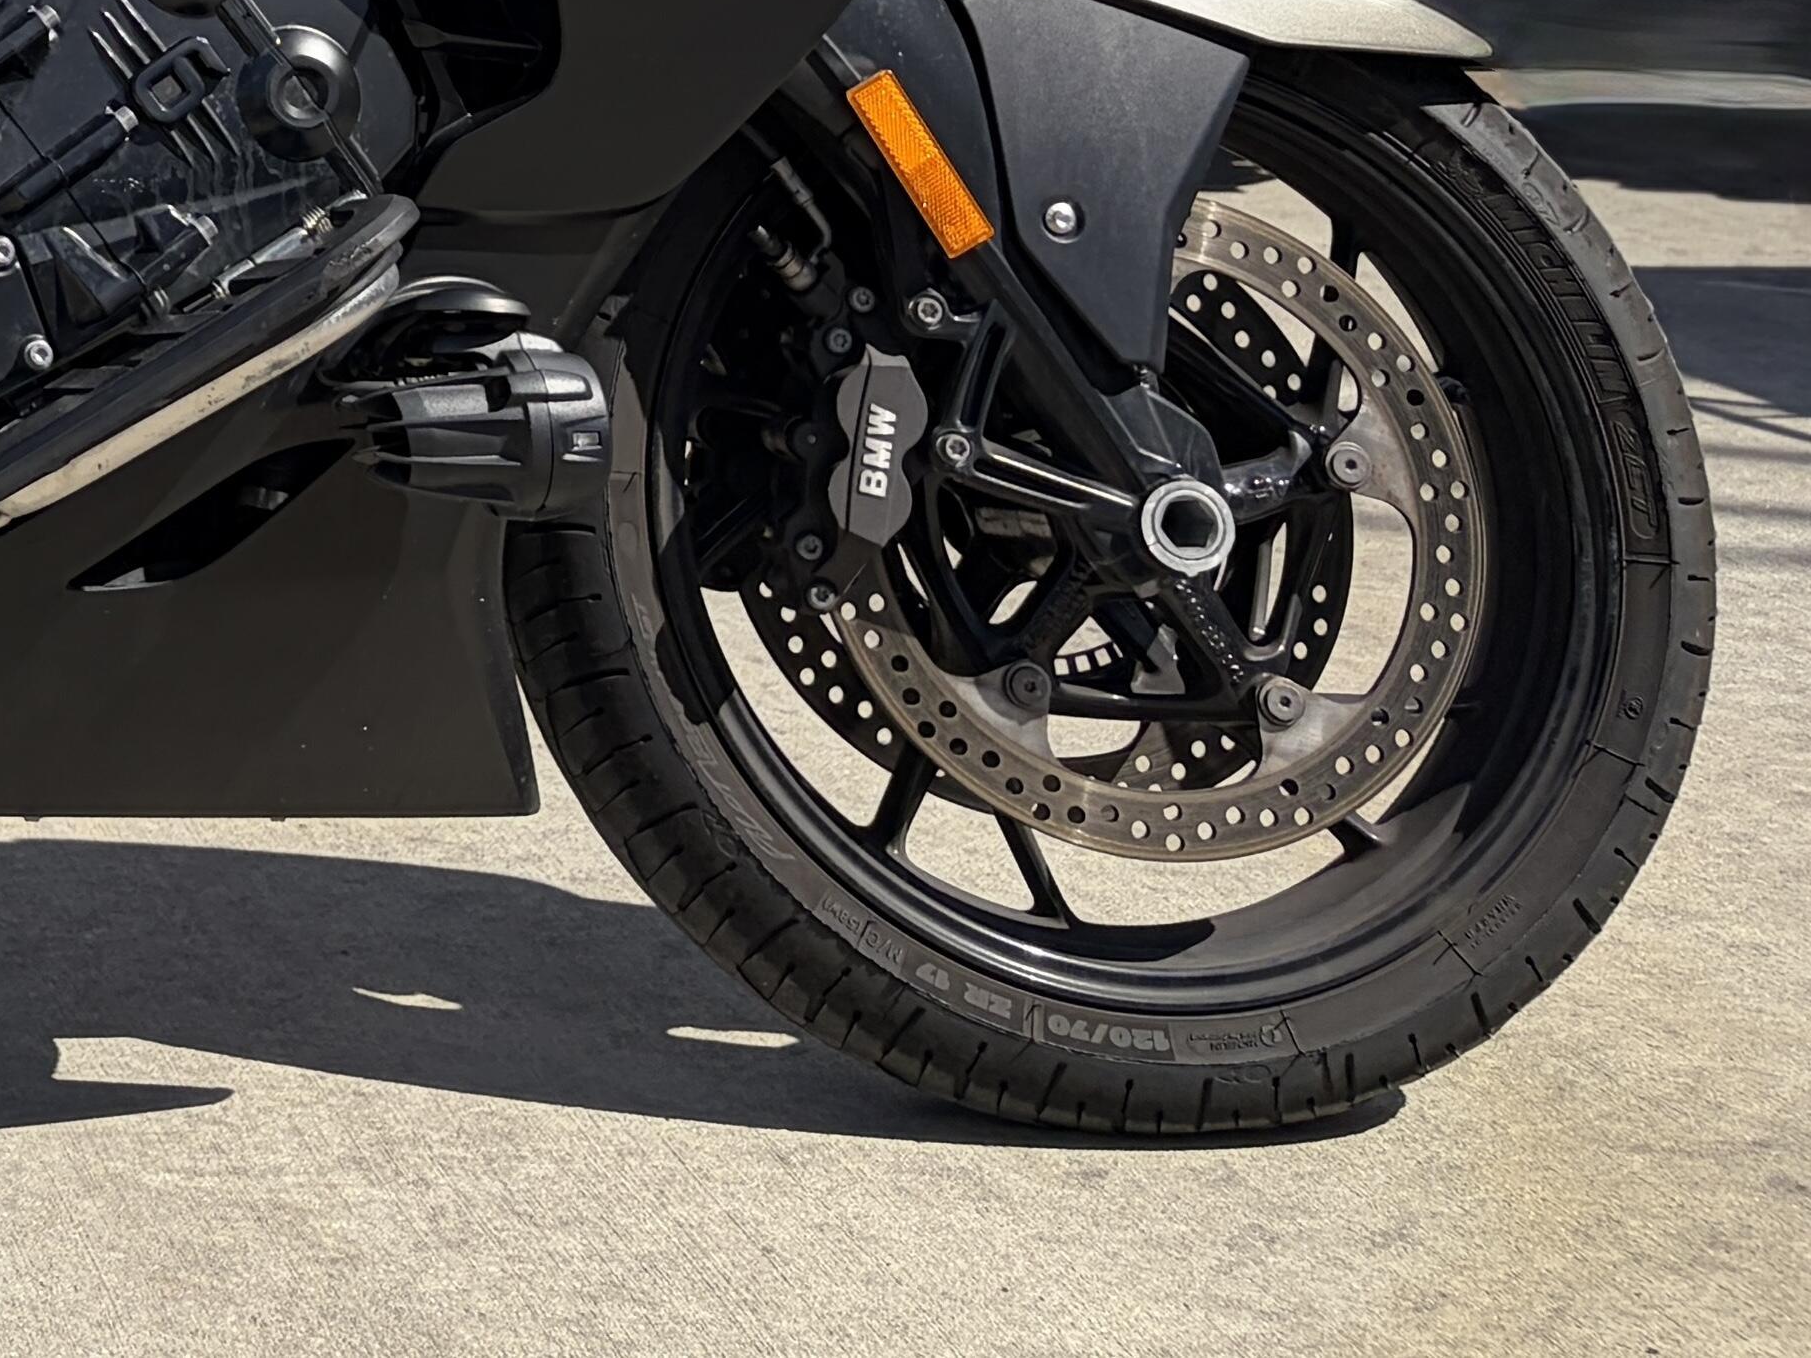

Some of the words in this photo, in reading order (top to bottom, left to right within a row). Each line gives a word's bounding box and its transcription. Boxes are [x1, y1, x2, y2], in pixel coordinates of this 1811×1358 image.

[858, 402, 898, 498] BMW
[915, 962, 951, 991] 17
[964, 982, 1012, 1019] ZR
[1046, 1013, 1173, 1054] 120/70
